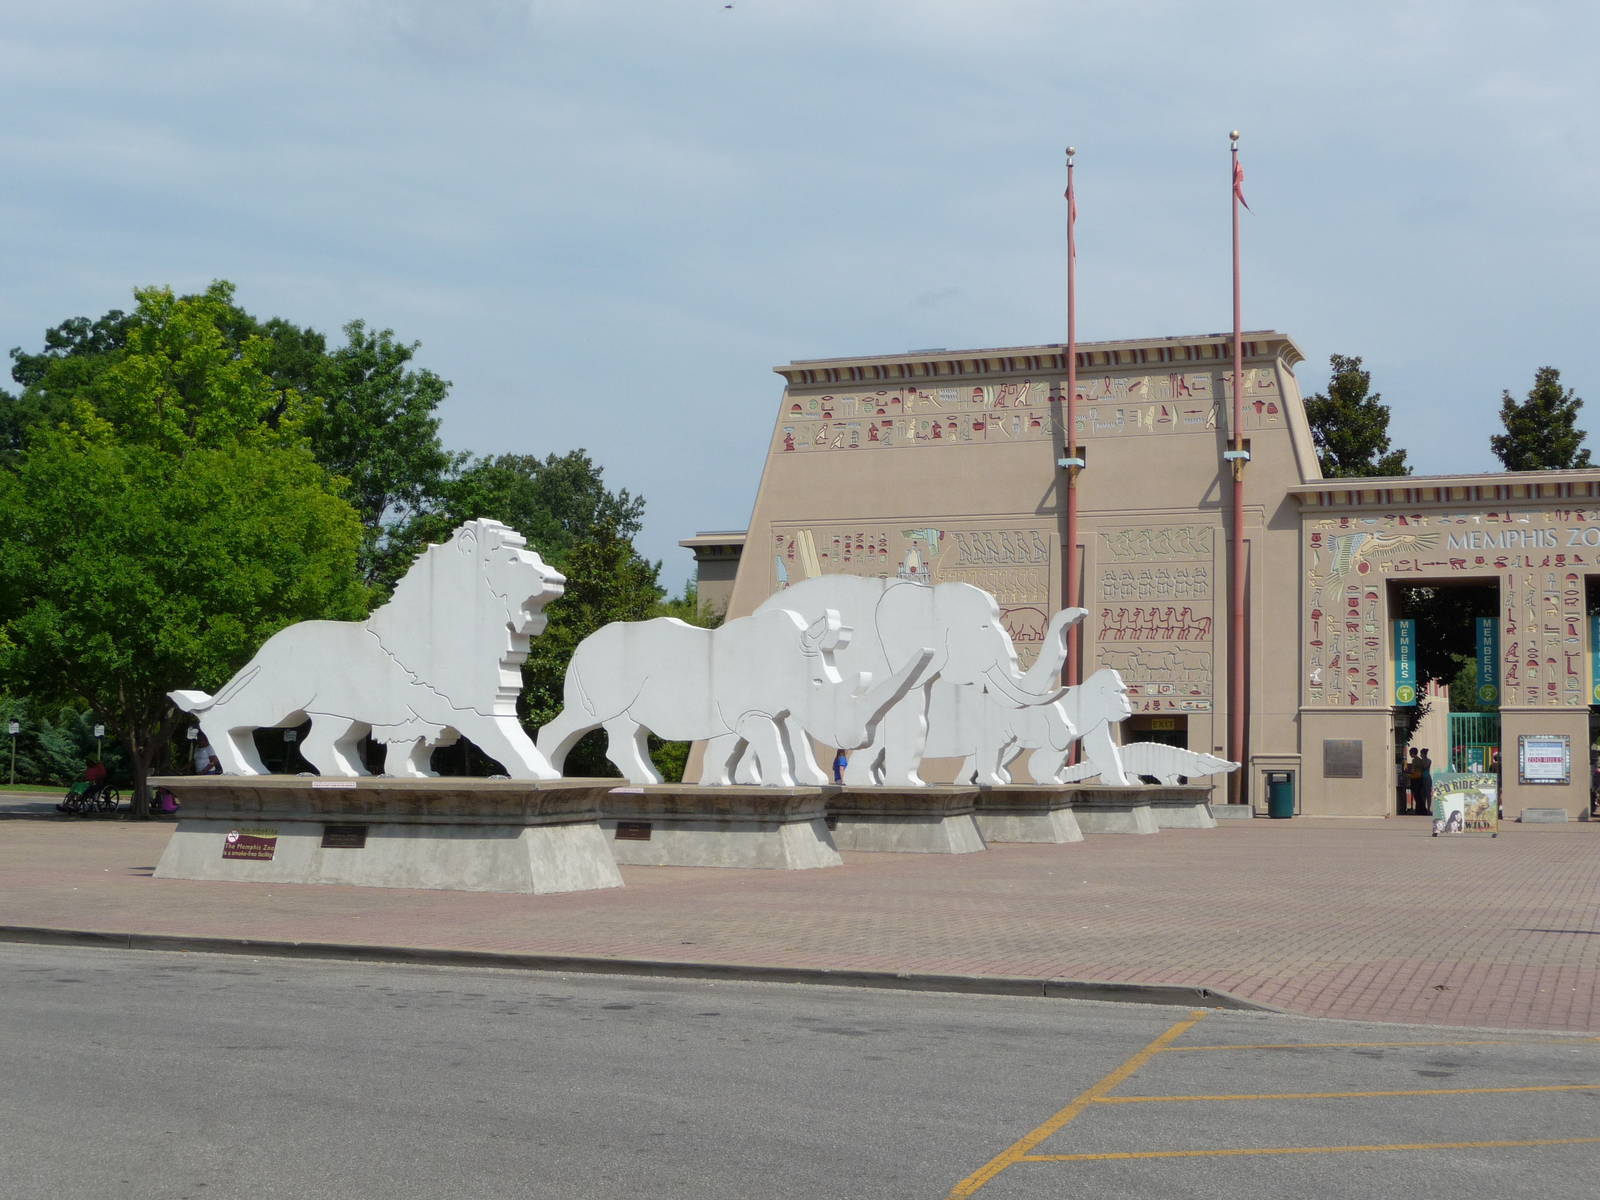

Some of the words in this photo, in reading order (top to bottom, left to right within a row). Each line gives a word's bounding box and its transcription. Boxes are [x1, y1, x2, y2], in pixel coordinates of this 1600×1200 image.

[1447, 527, 1558, 549] MEMPHIS
[1400, 620, 1409, 678] MEMBERS
[1483, 618, 1493, 682] MEMBERS
[1152, 719, 1173, 729] EXIT
[1465, 821, 1490, 829] WILD
[237, 843, 262, 851] Memphis
